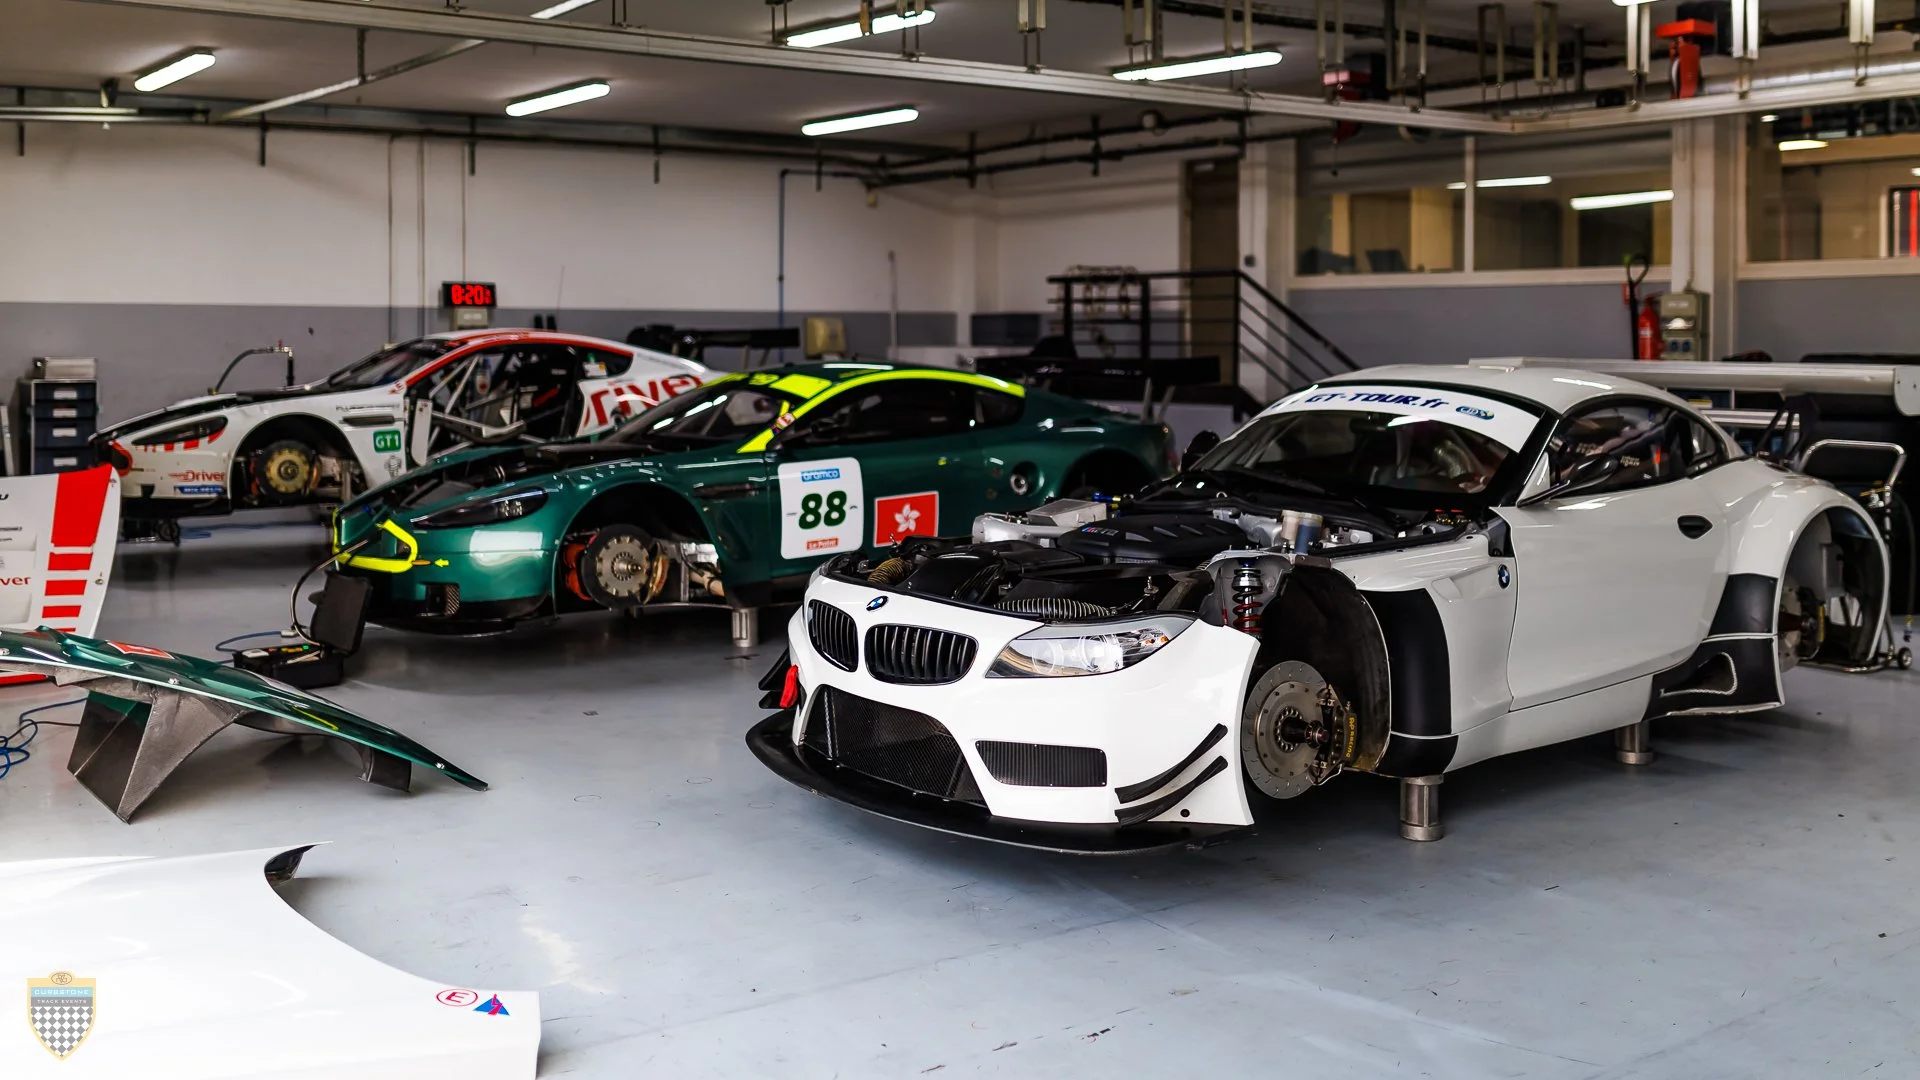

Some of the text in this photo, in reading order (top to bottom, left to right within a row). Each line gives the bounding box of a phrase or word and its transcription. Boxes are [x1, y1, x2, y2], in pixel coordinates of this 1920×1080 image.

[375, 434, 399, 449] GT1
[185, 470, 225, 482] Driver
[802, 469, 839, 482] aramco
[798, 490, 847, 530] 88
